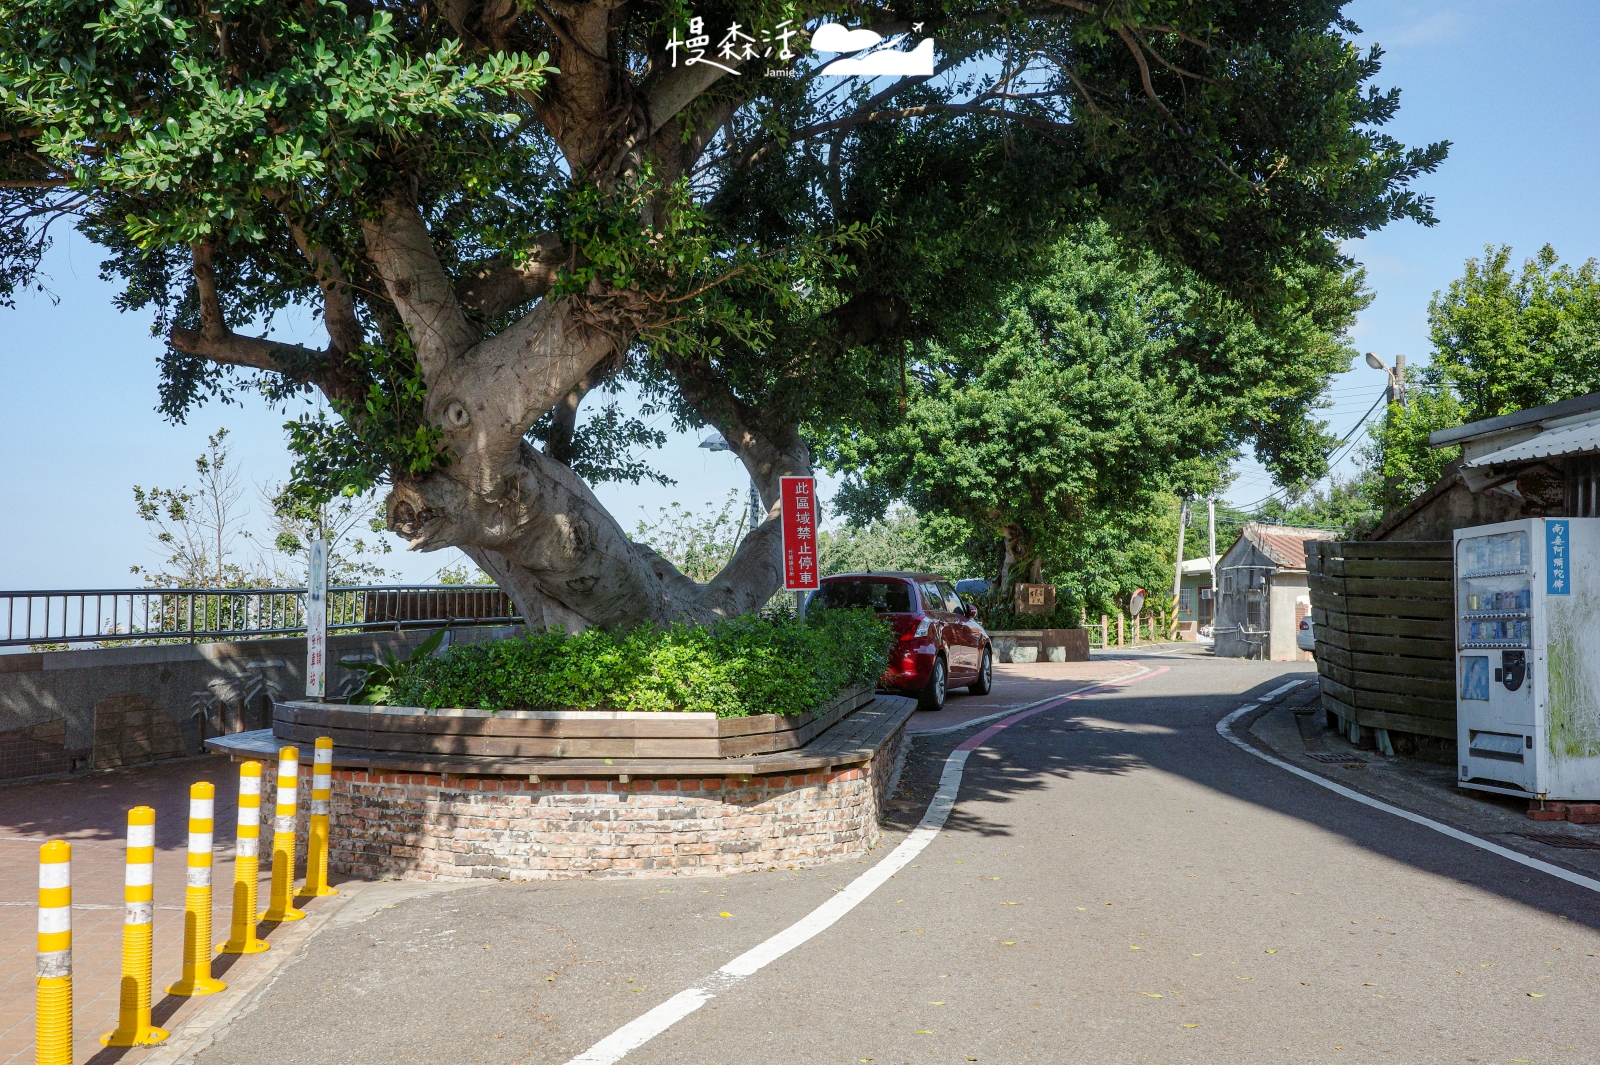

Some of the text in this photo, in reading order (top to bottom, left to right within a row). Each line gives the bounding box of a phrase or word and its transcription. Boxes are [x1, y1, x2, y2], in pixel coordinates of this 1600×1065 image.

[795, 481, 814, 585] 此區域禁止停車
